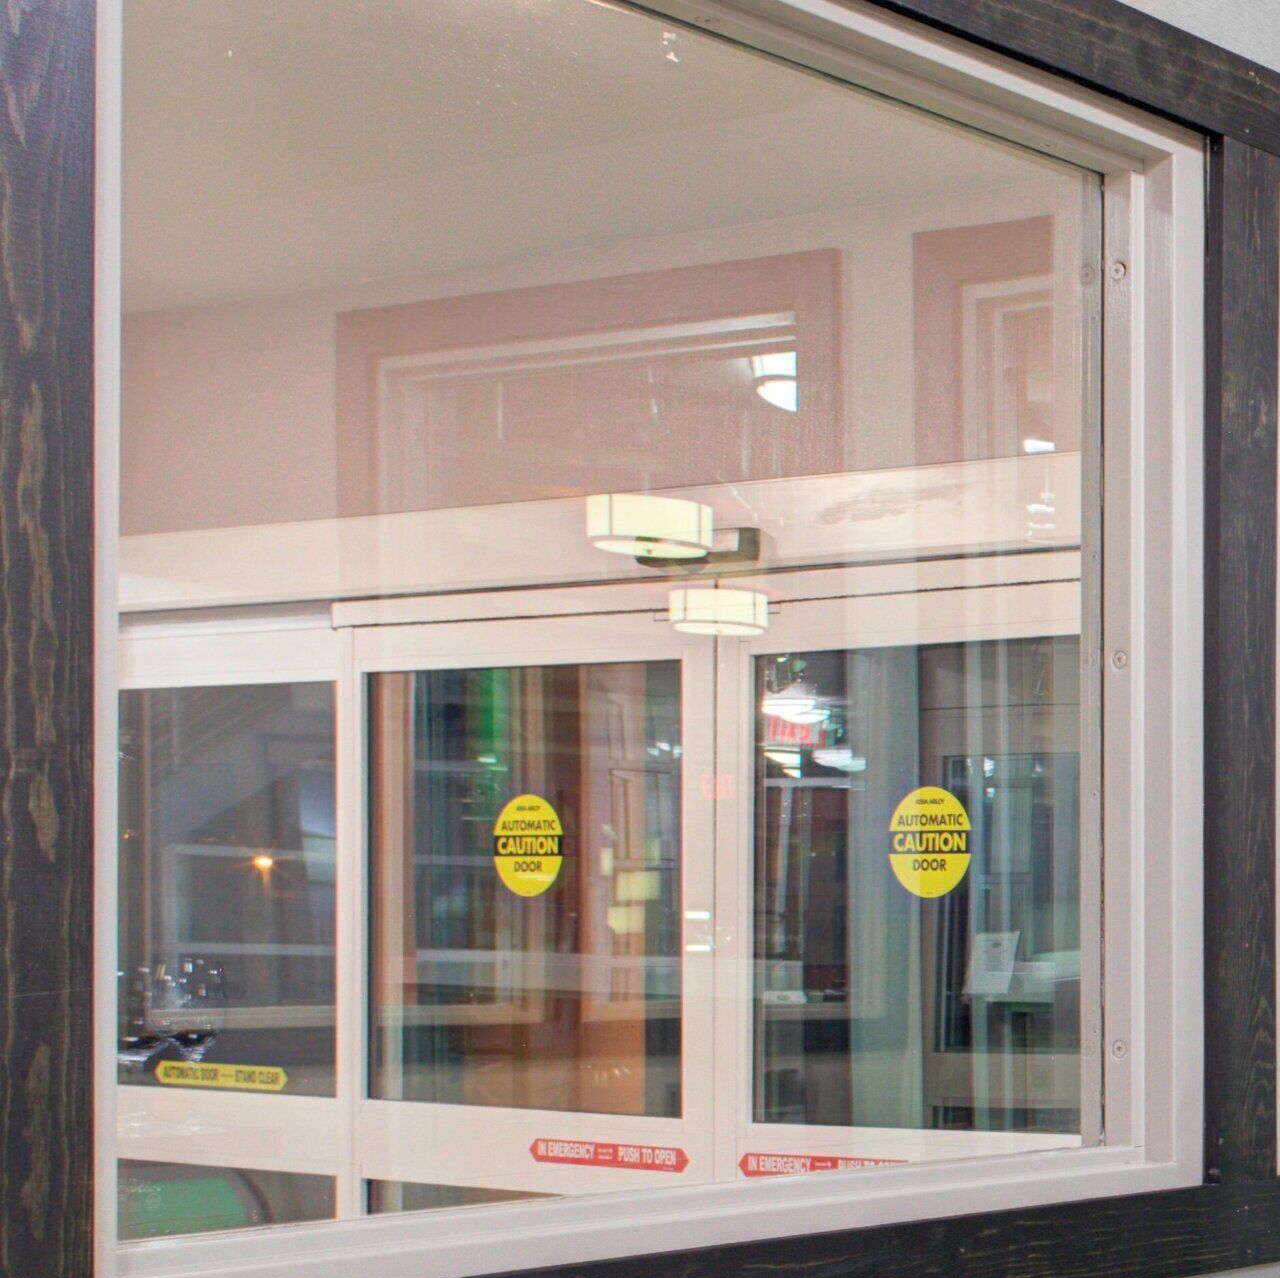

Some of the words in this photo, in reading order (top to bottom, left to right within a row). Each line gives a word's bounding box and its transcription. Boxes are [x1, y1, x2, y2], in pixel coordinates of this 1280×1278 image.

[501, 820, 556, 831] AUTOMATIC
[897, 814, 964, 827] AUTOMATIC
[497, 837, 559, 855] CAUTION
[893, 832, 967, 852] CAUTION
[513, 861, 543, 872] DOOR
[913, 859, 947, 871] DOOR
[163, 1066, 199, 1080] AUTOMATIC
[201, 1067, 218, 1081] DOOR
[234, 1070, 257, 1084] STAND
[258, 1072, 280, 1085] CLEAR
[537, 1141, 546, 1156] IN
[548, 1142, 595, 1160] EMERGENCY
[617, 1146, 640, 1162] PUSH
[642, 1148, 653, 1164] TO
[655, 1149, 677, 1165] OPEN
[748, 1155, 758, 1171] IN
[759, 1156, 812, 1173] EMERGENCY
